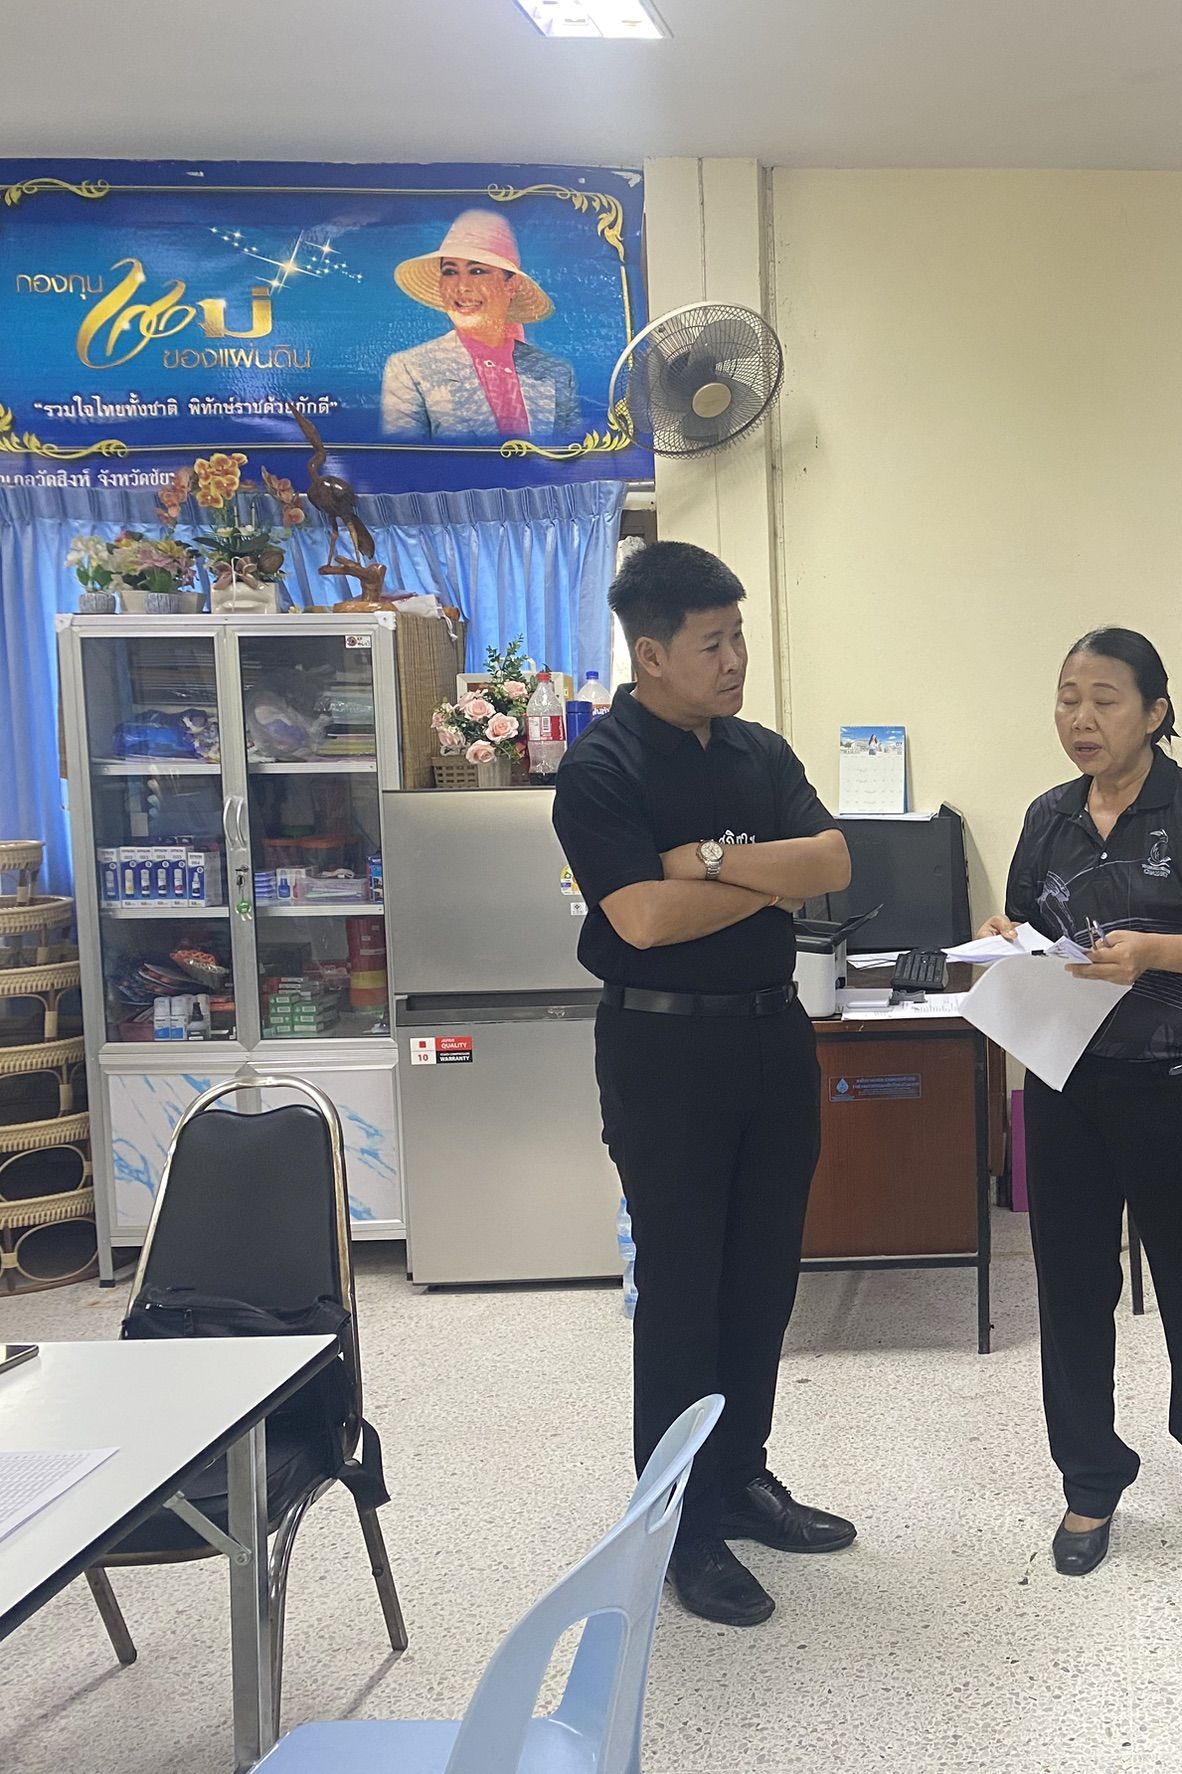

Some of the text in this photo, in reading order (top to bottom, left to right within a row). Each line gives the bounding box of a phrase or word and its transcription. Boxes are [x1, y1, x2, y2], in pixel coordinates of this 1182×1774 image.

[16, 273, 103, 299] กองทุน
[162, 342, 312, 370] ของแผ่นดิน
[97, 468, 177, 488] จังหวัดชัย
